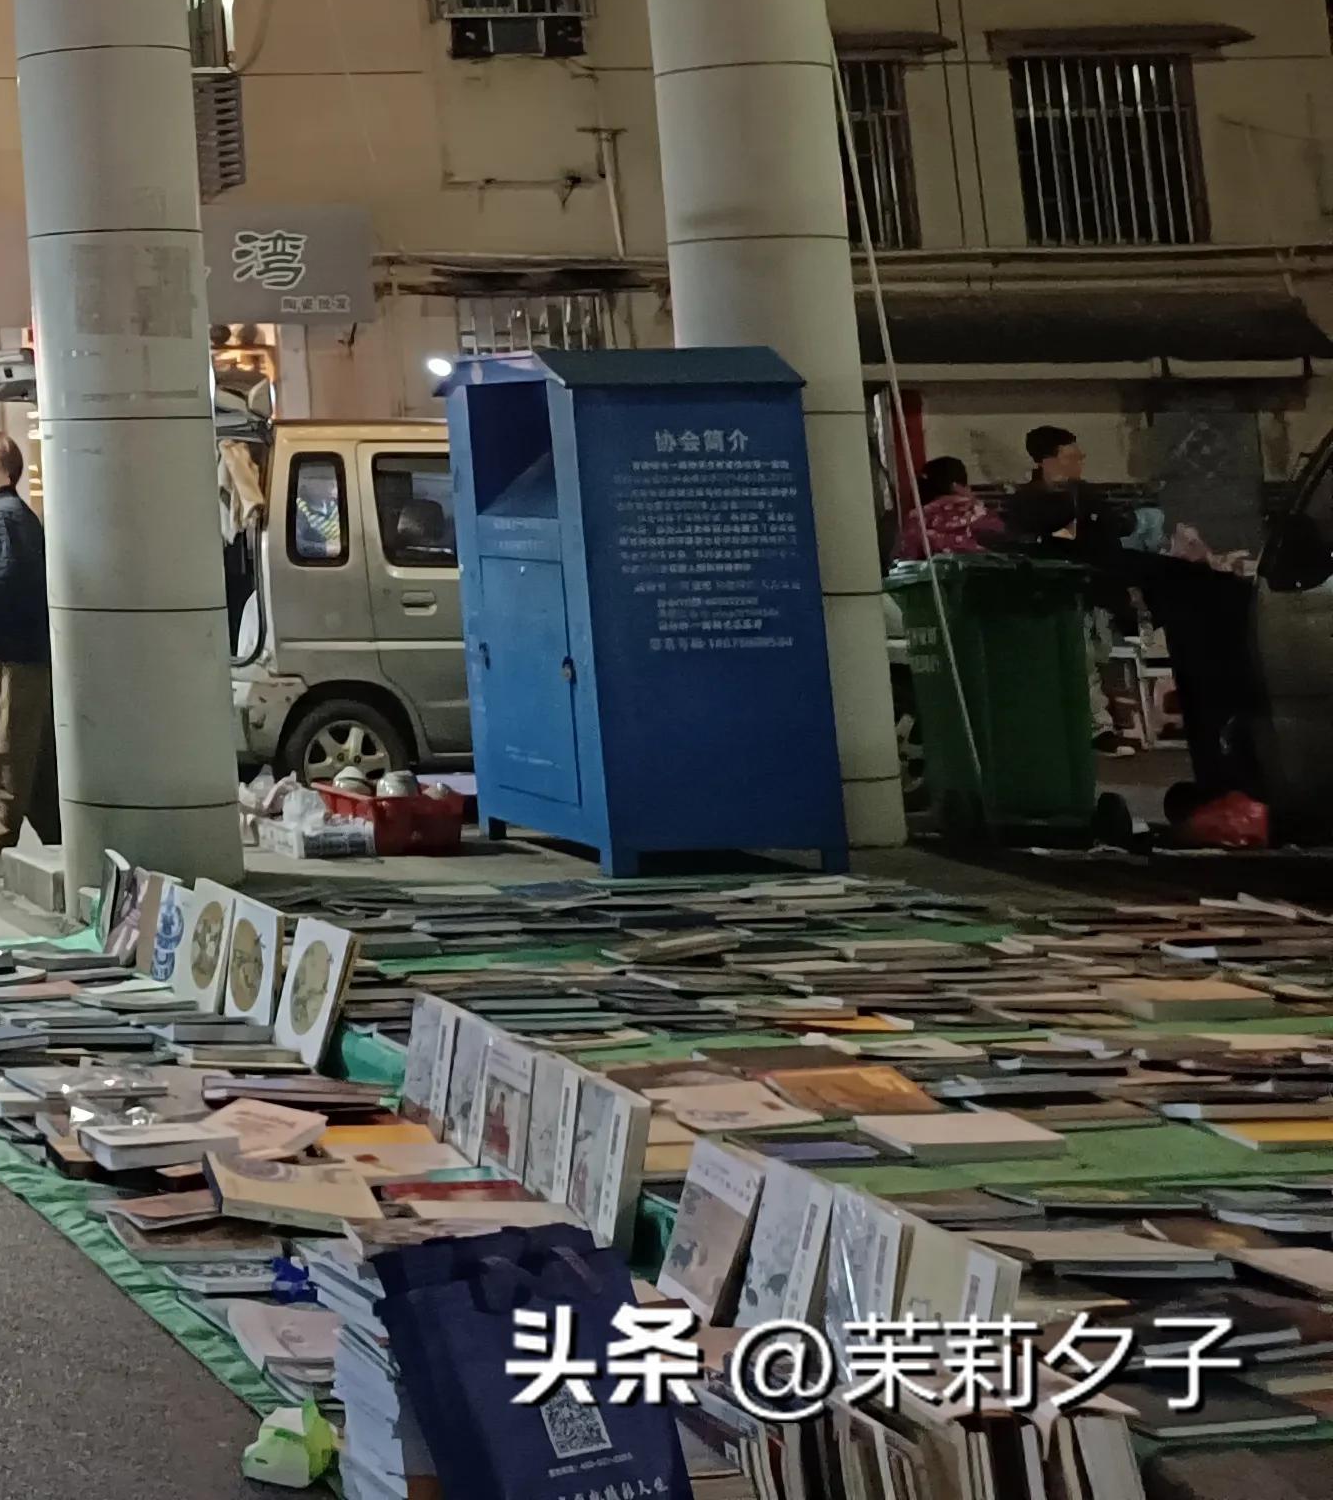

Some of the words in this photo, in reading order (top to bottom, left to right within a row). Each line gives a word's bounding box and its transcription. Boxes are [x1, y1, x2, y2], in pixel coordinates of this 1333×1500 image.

[232, 229, 308, 290] 湾
[655, 428, 749, 453] 协会简介
